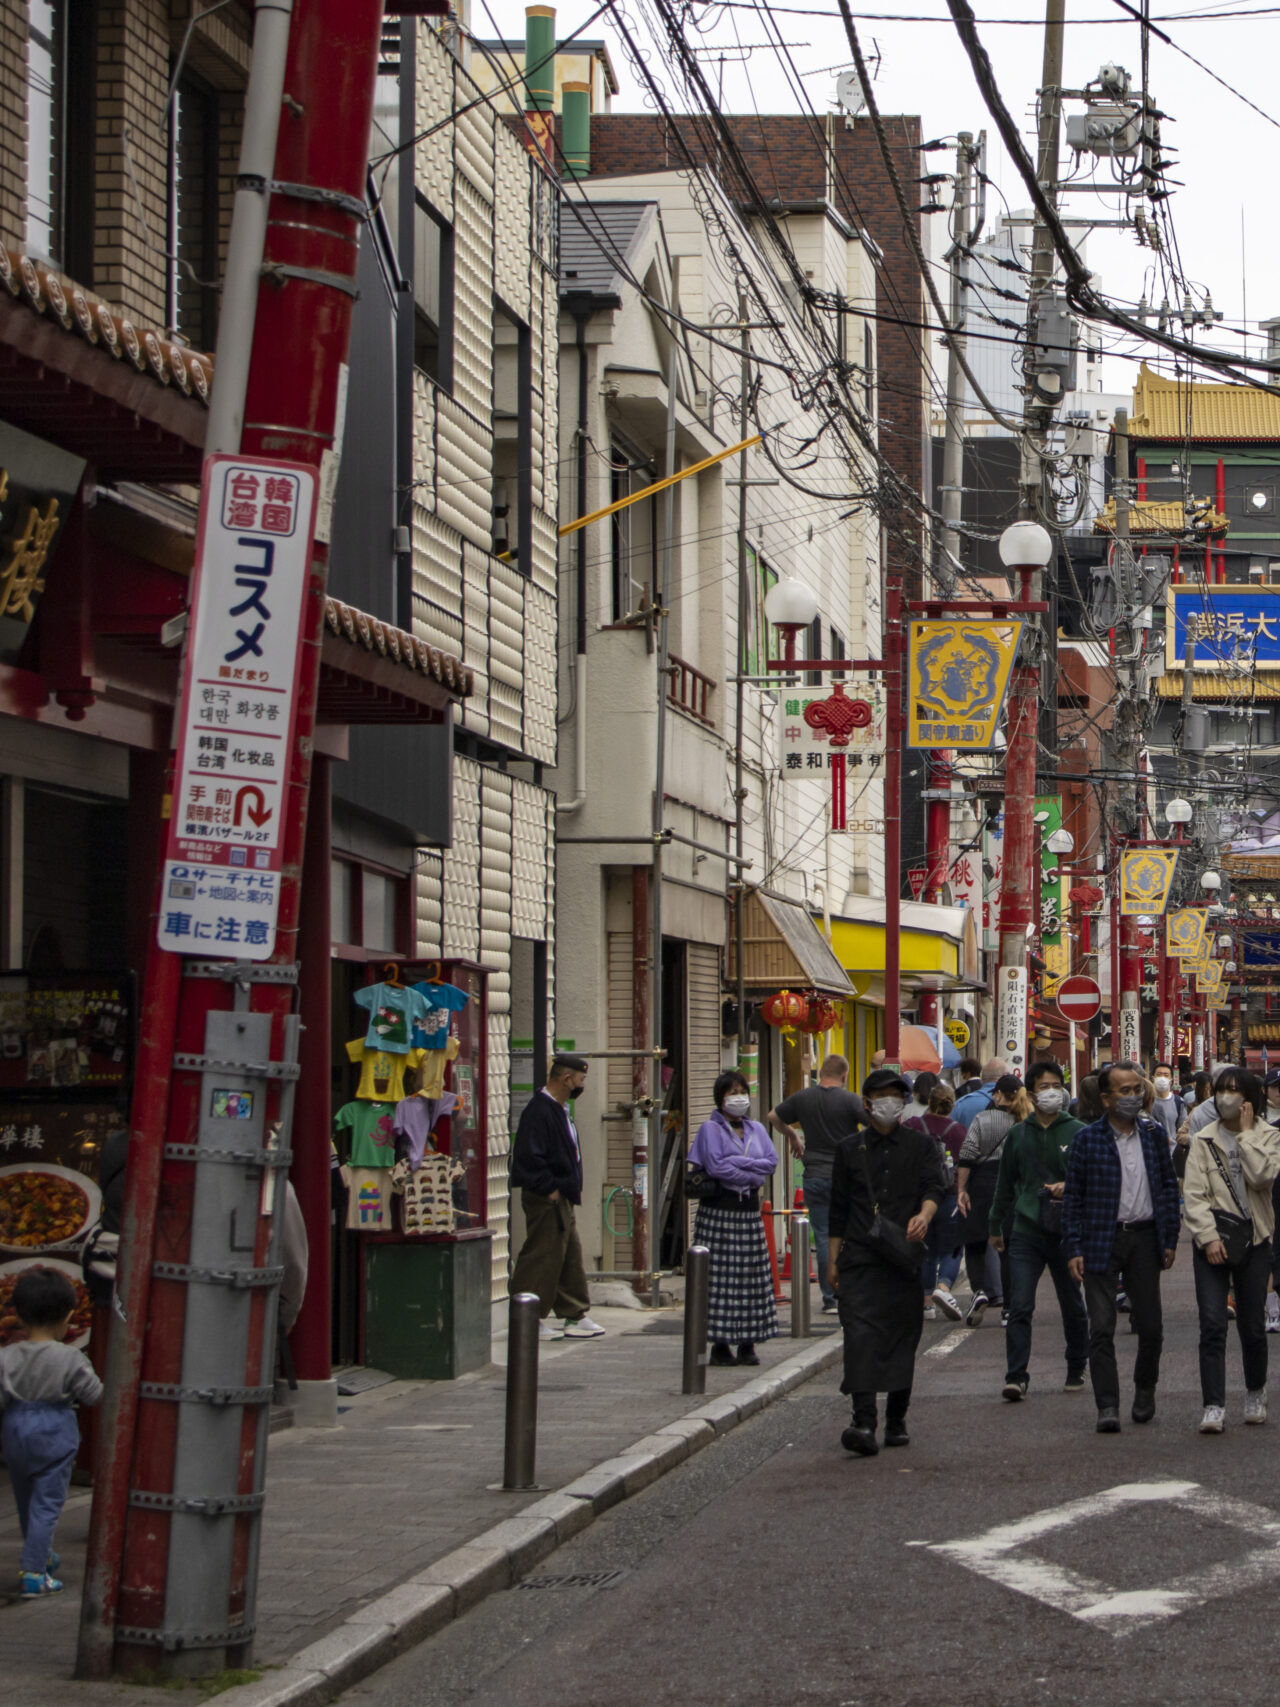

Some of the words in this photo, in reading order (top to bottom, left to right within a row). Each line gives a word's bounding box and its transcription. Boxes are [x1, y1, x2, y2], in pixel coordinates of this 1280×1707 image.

[224, 537, 275, 663] コスメ
[202, 687, 232, 704] 한국
[200, 707, 230, 724] 대만
[235, 700, 280, 722] 화장품
[164, 911, 270, 945] 車に注意
[1125, 1015, 1135, 1036] BAR
